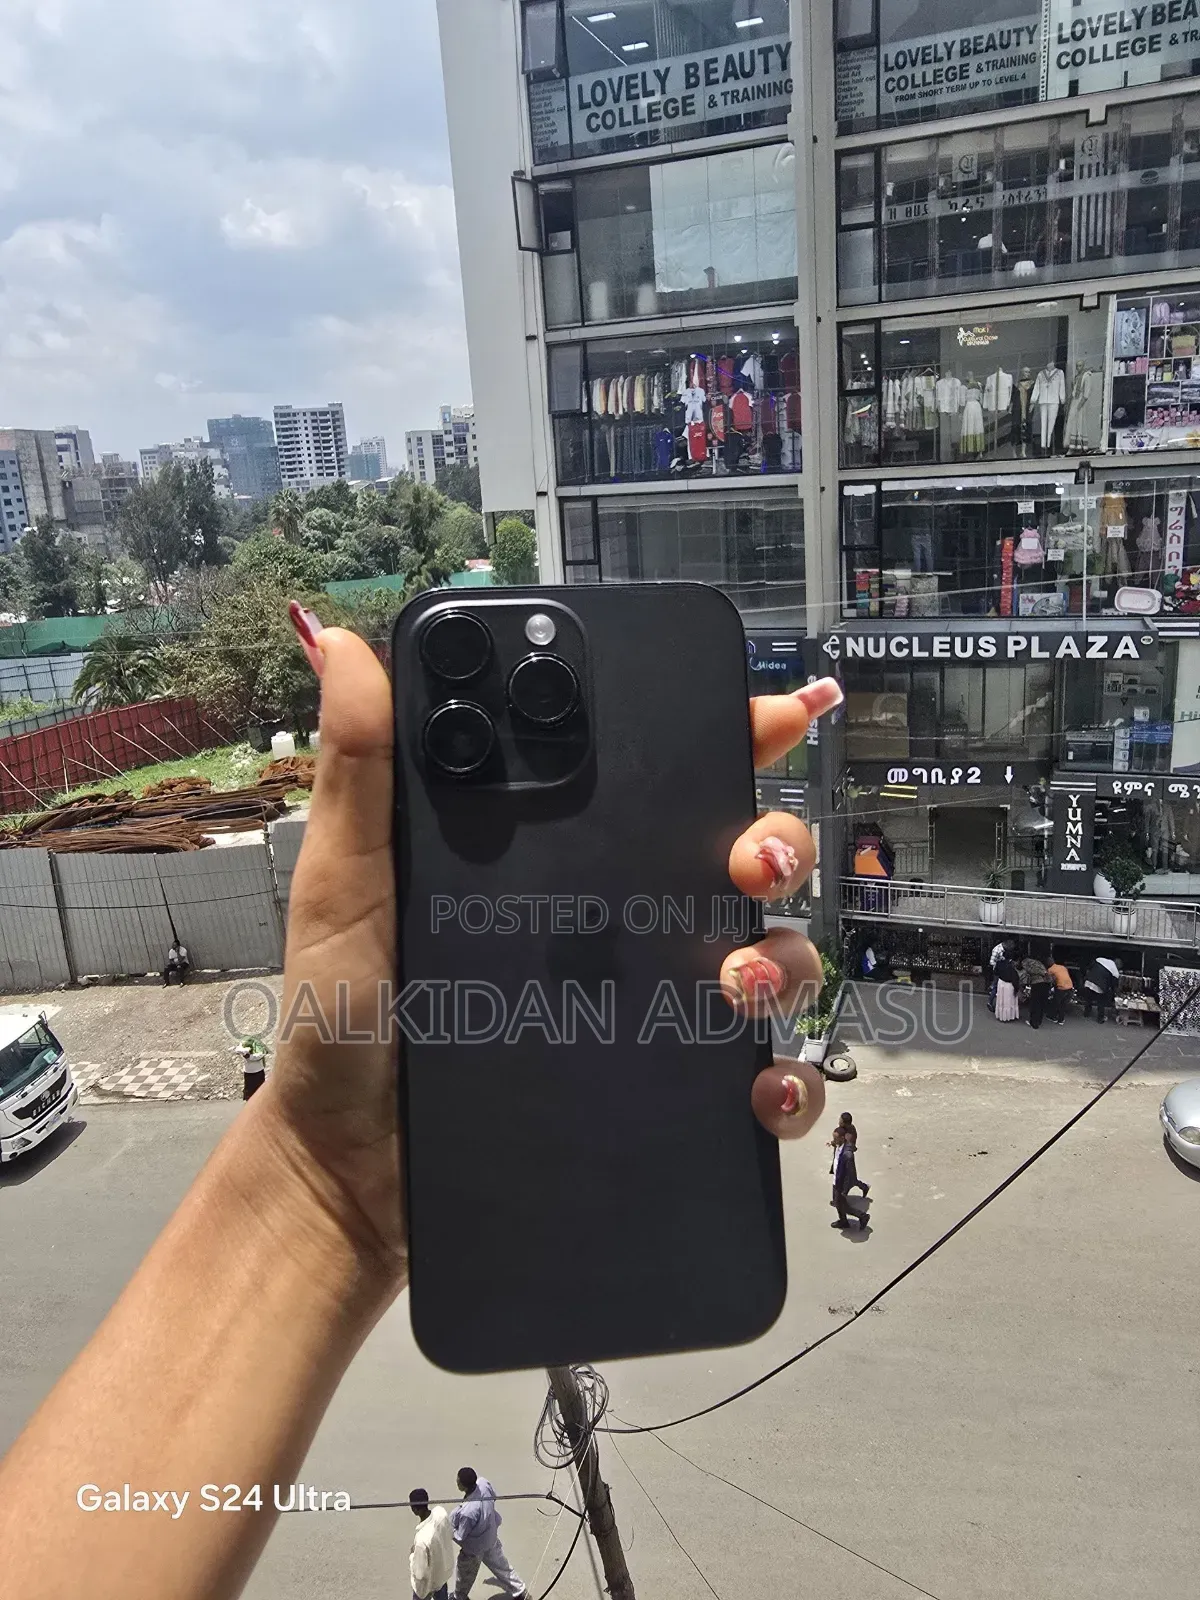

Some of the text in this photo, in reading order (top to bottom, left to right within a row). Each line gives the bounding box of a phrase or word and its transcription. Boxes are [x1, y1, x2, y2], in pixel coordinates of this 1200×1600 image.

[1057, 0, 1200, 45] LOVELY BEA
[884, 23, 1038, 73] LOVELY BEAUTY
[1056, 33, 1162, 70] COLLEGE
[1169, 33, 1179, 46] &
[577, 41, 792, 111] LOVELY BEAUTY
[884, 51, 1037, 94] COLLEGE & TRAINING
[894, 92, 916, 103] FROM
[917, 88, 943, 99] SHORT
[945, 83, 967, 94] TERM
[969, 80, 980, 90] UP
[981, 78, 992, 87] TO
[994, 73, 1020, 85] LEVEL
[585, 78, 794, 133] COLLEGE & TRAINING
[757, 660, 787, 671] Midea
[845, 635, 1140, 660] NUCLEUS PLAZA
[1065, 794, 1084, 861] YUMNA
